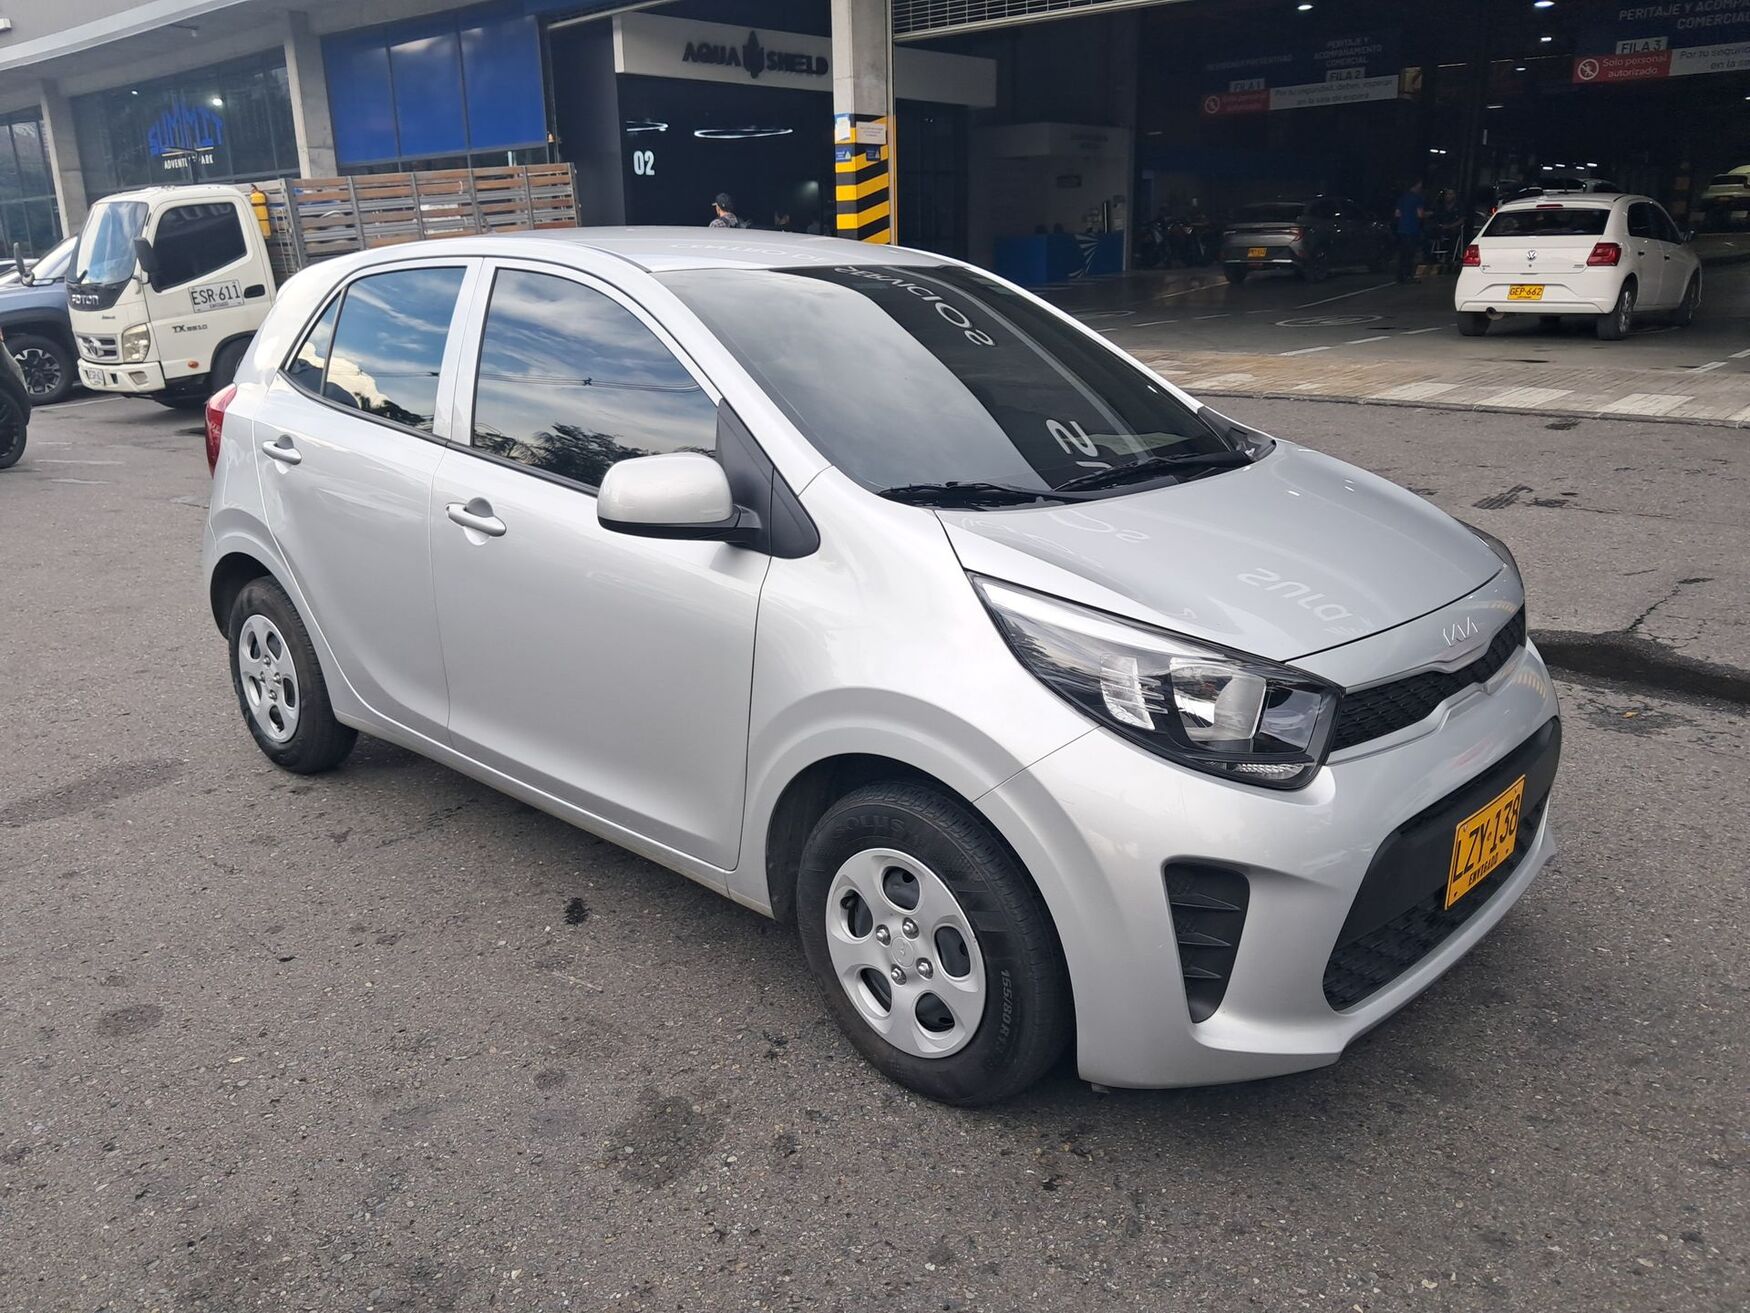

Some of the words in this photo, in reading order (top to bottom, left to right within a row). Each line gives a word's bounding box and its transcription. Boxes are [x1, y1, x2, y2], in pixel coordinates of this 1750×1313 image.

[1618, 3, 1681, 21] PERITAJE
[1684, 2, 1695, 13] Y
[1621, 41, 1650, 53] FILA
[1654, 39, 1662, 51] 3
[682, 41, 742, 66] AQUA
[766, 50, 830, 75] SHIELD
[1603, 58, 1623, 67] Solo
[1625, 55, 1668, 67] personal
[1330, 70, 1353, 81] FILA
[1354, 69, 1361, 80] 2
[1607, 66, 1658, 78] autorizado
[198, 154, 214, 165] ARK
[633, 150, 655, 176] 02
[71, 294, 99, 305] FOTON
